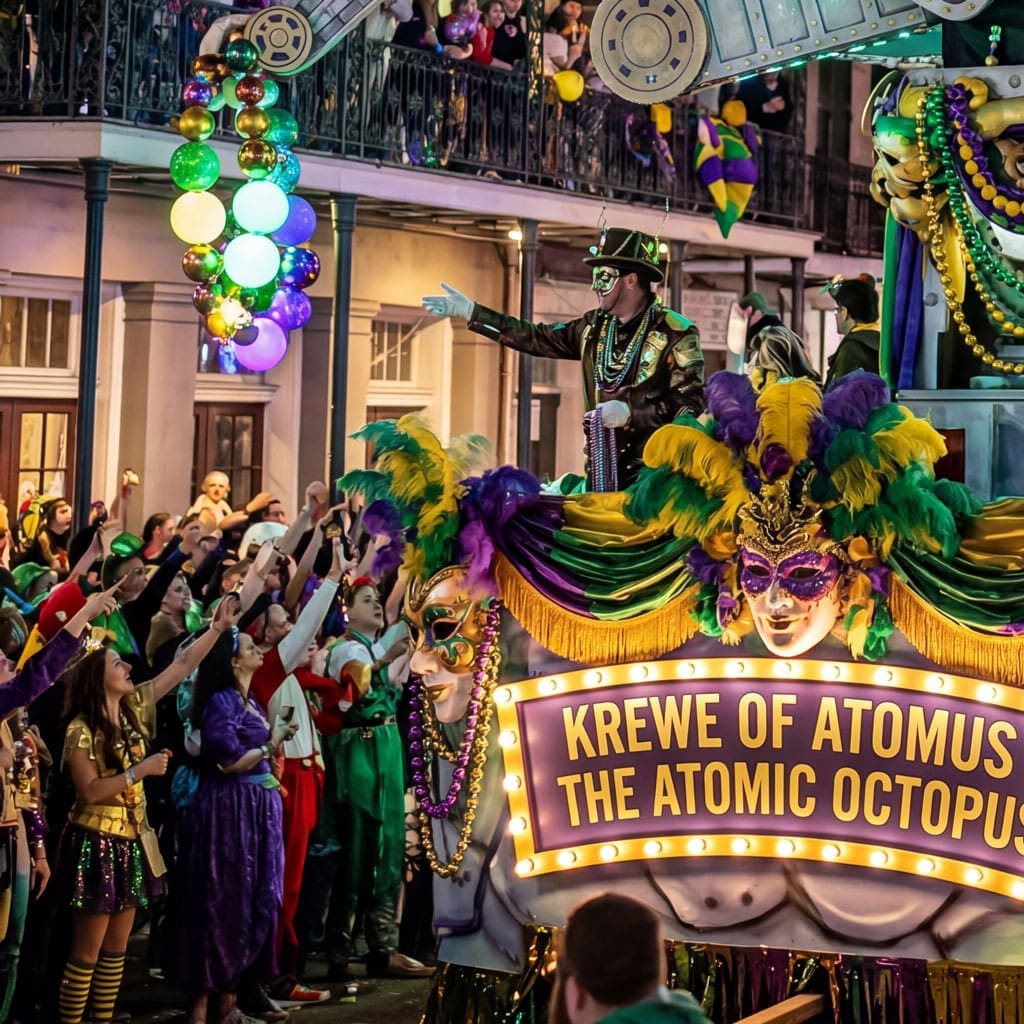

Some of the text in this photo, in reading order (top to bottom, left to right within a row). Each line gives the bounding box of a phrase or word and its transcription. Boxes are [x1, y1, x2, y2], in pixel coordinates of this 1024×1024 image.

[562, 692, 722, 761] KREWE
[738, 693, 797, 750] OF
[811, 697, 1018, 779] ATOMUS
[556, 766, 640, 827] THE
[653, 761, 816, 818] ATOMIC
